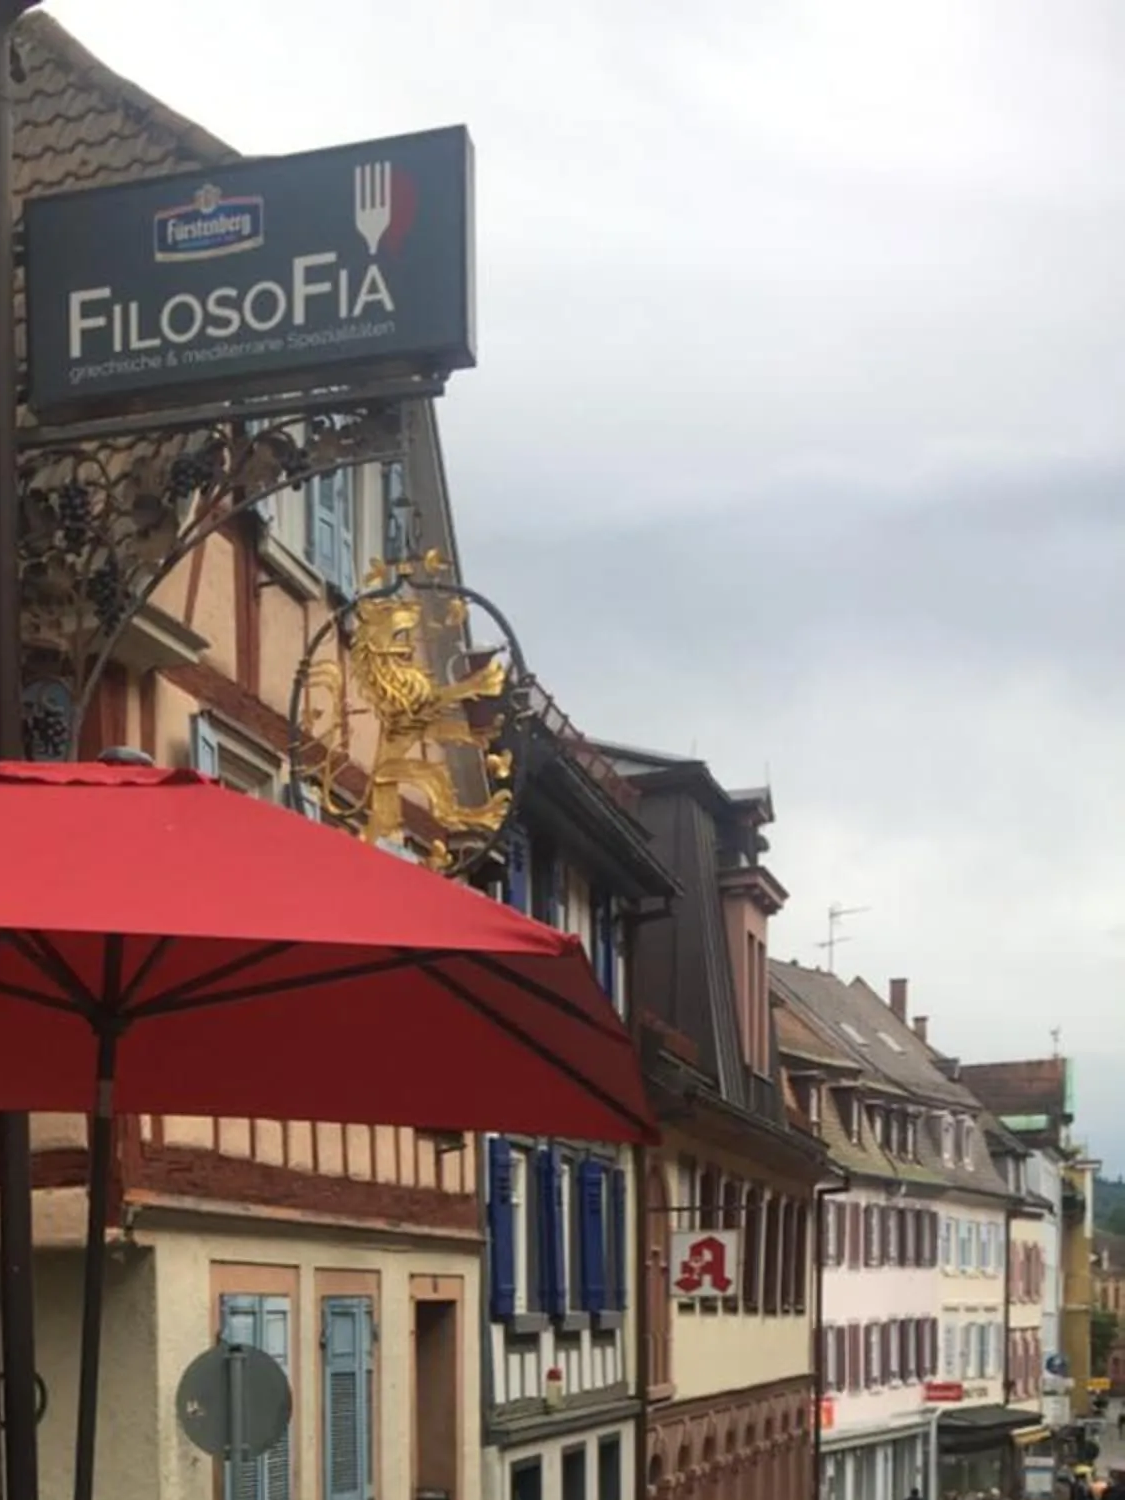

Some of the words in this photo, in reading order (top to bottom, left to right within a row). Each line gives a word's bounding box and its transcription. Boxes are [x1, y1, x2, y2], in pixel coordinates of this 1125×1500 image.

[167, 212, 251, 245] Fürstenberg
[69, 352, 162, 384] griechische
[183, 336, 284, 364] mediterrane
[287, 319, 396, 350] Spezialitäten
